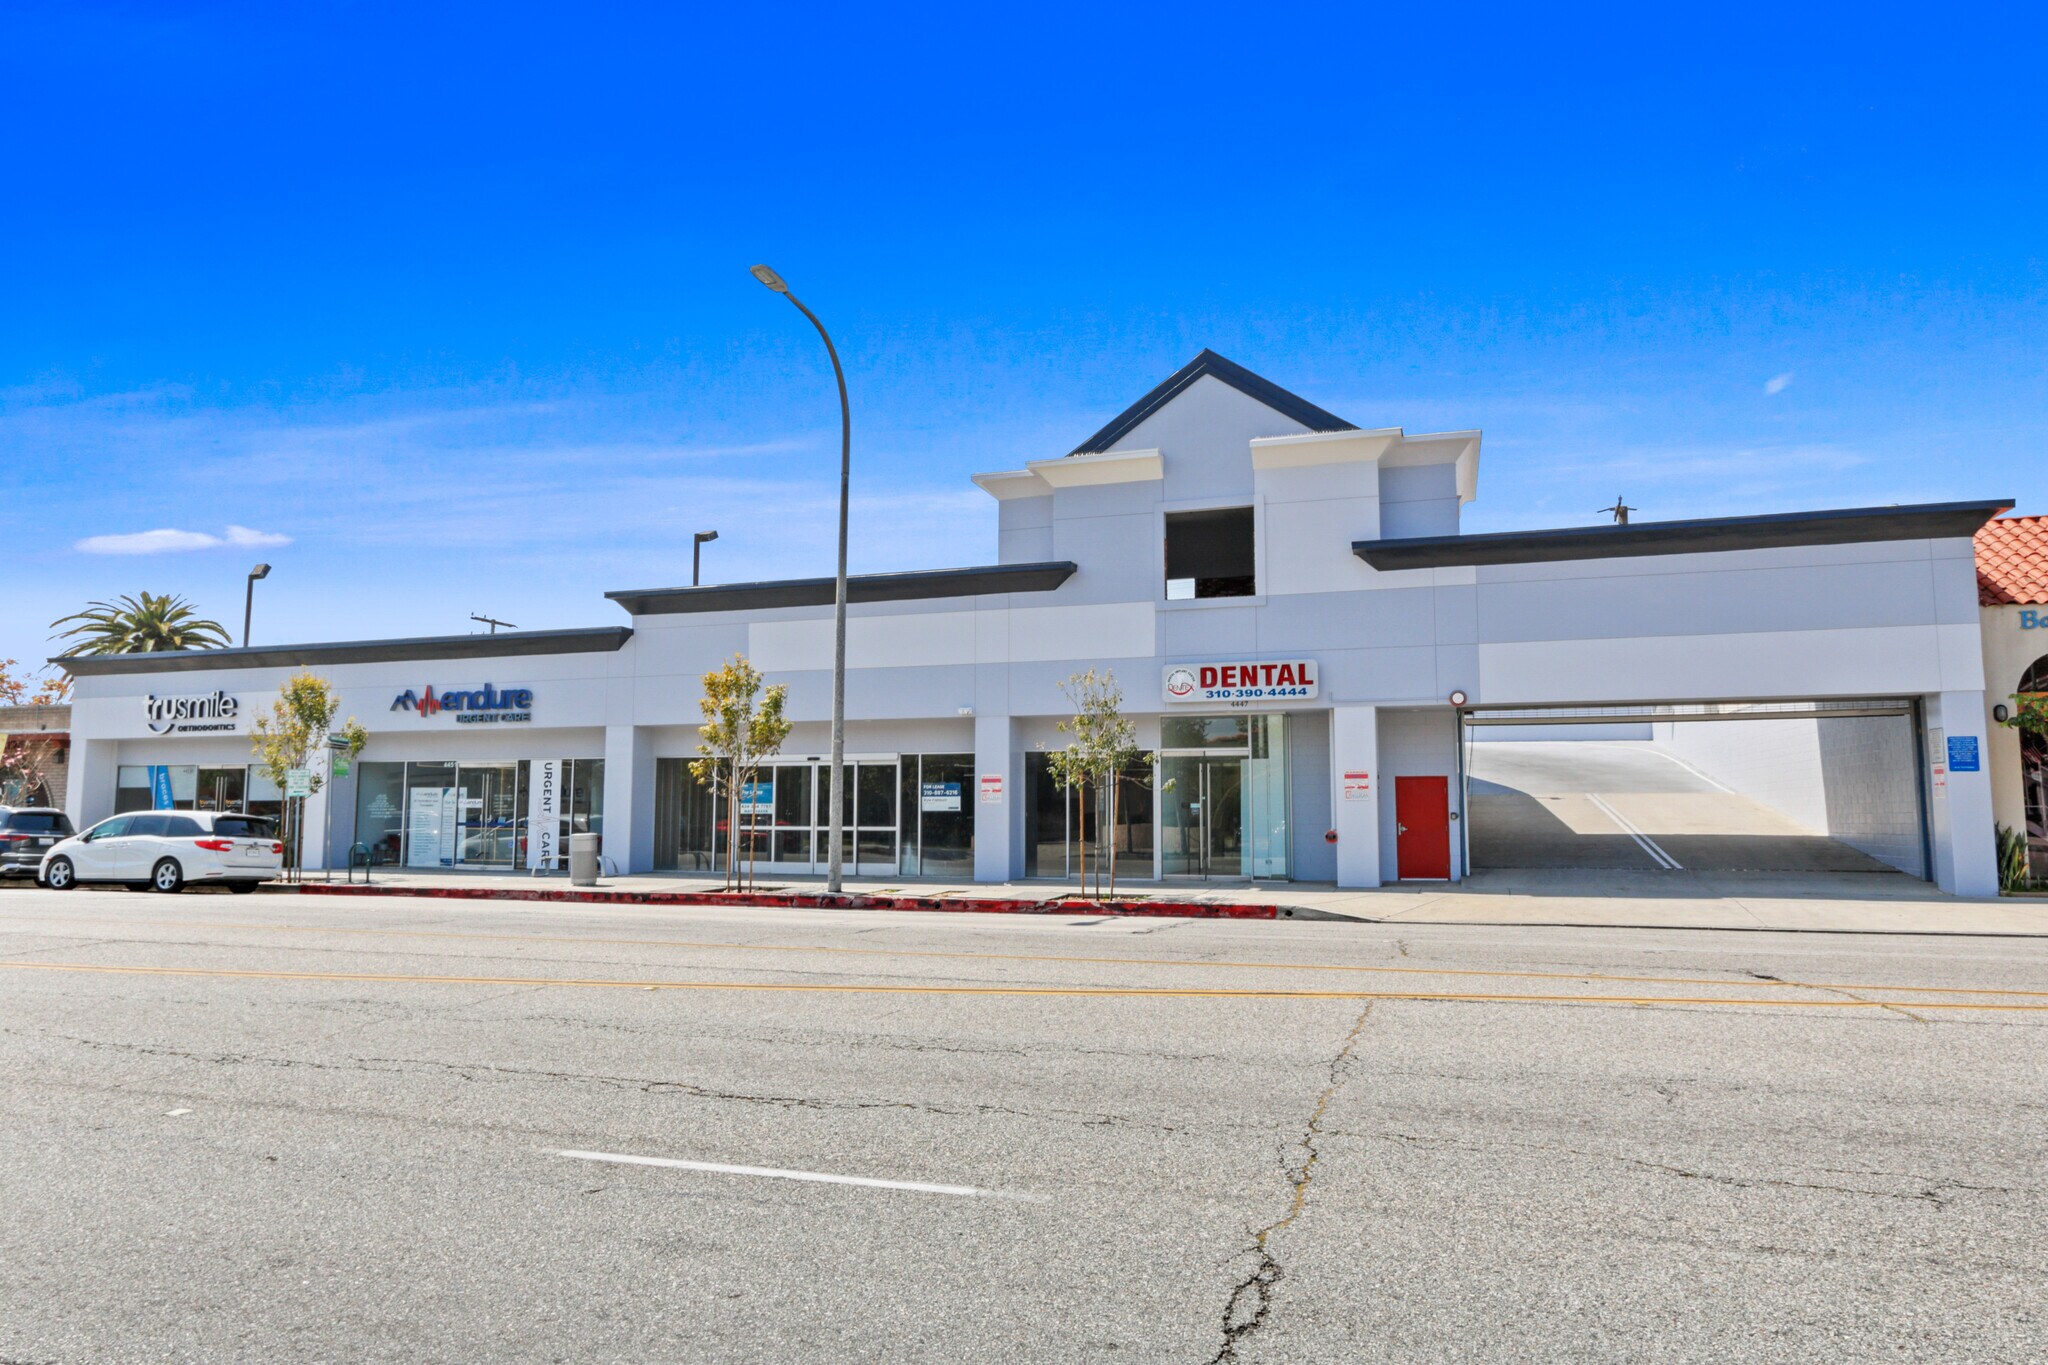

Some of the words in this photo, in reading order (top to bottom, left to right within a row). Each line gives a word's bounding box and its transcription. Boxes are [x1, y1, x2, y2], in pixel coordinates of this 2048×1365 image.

[1200, 663, 1314, 688] DENTAL
[143, 690, 238, 720] trusmile
[441, 683, 532, 711] endure
[177, 723, 236, 732] ORTHODONTICS
[456, 712, 499, 723] URGENT
[501, 712, 531, 722] CARE
[542, 762, 553, 814] URGENT
